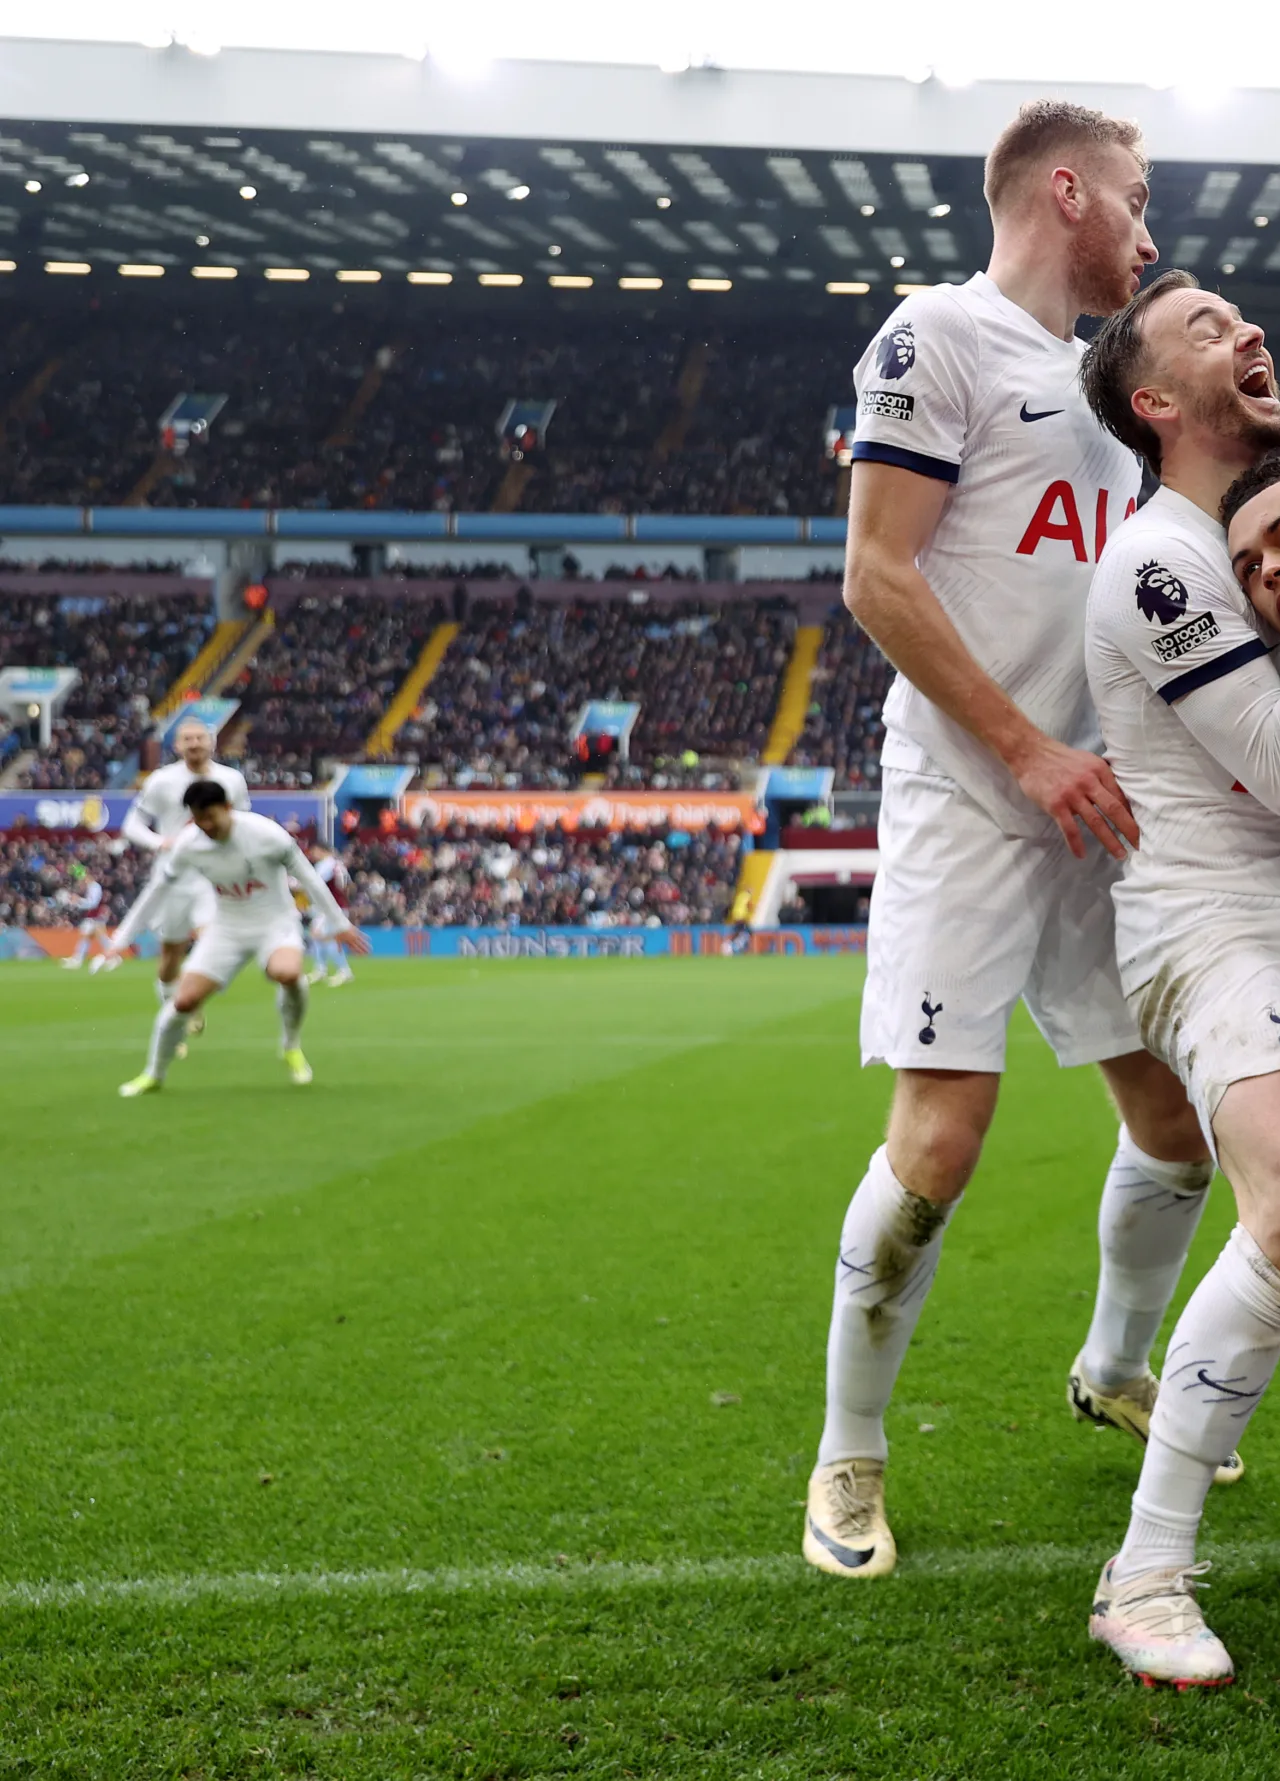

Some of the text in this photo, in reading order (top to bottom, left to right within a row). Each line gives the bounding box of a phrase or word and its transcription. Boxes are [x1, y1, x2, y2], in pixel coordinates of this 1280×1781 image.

[873, 404, 912, 420] racism
[874, 393, 908, 408] room
[1015, 480, 1136, 564] AI
[1152, 617, 1211, 653] No room
[1159, 624, 1220, 663] for racism
